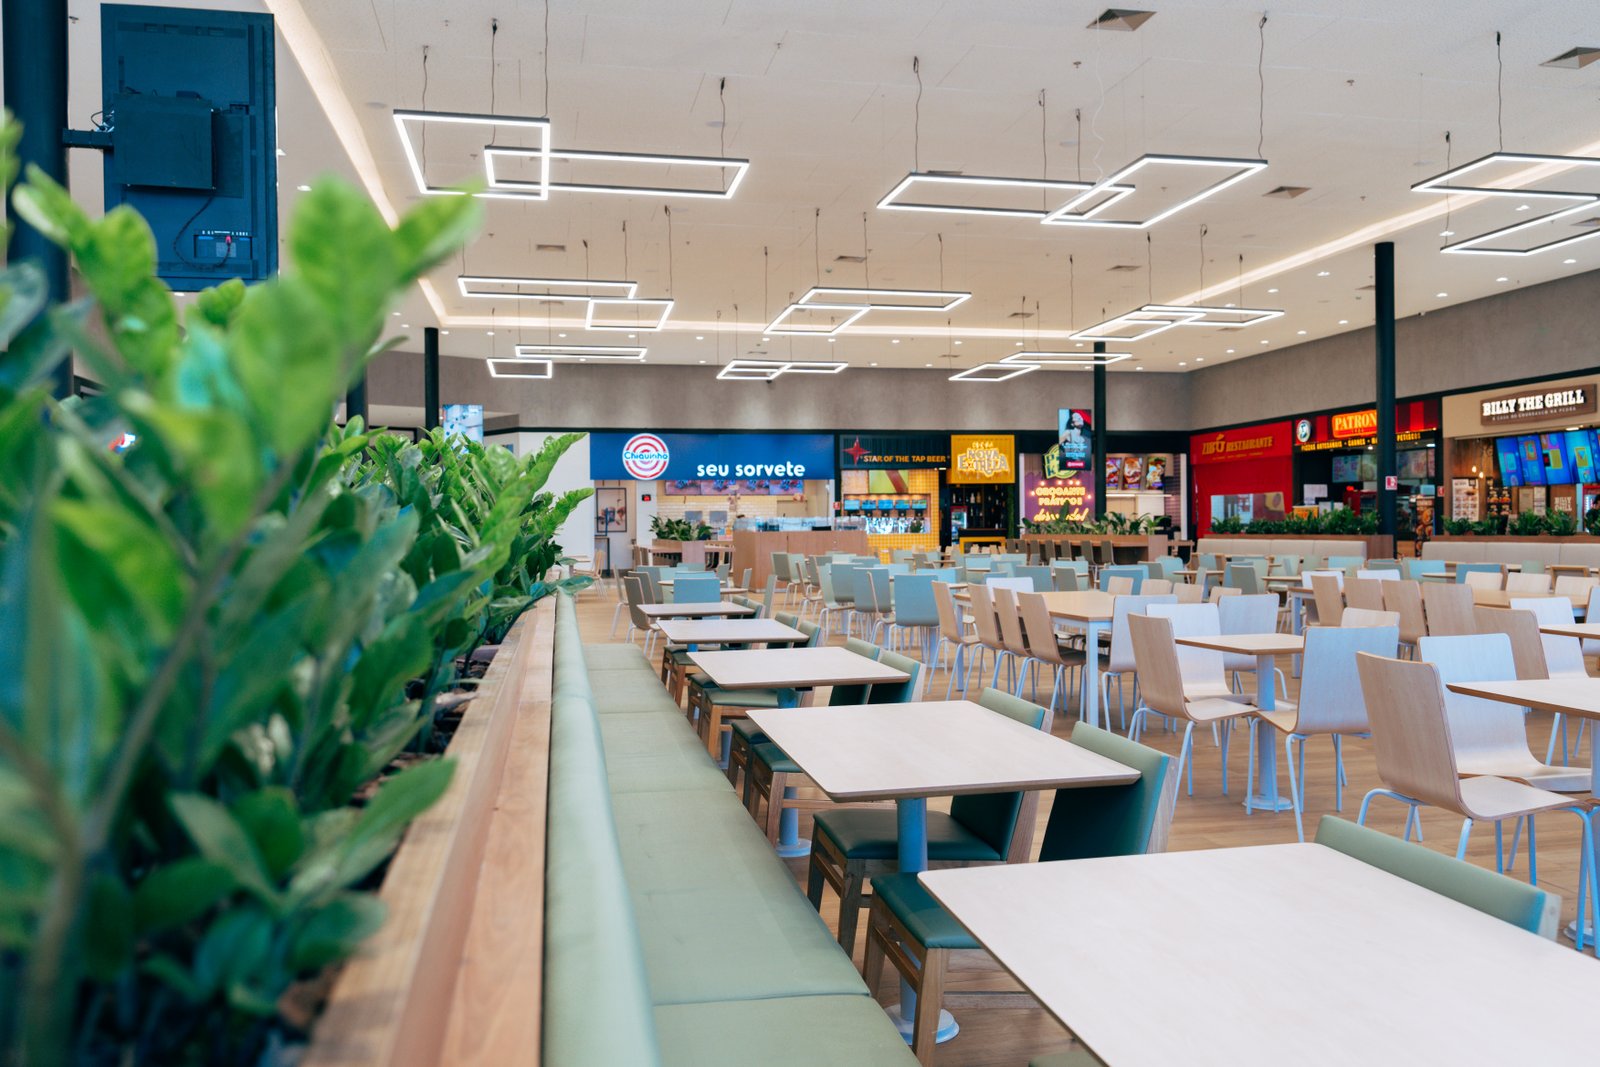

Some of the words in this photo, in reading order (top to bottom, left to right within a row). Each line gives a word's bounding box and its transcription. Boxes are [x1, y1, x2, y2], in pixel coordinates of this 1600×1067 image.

[1482, 398, 1516, 416] BILLY
[1518, 395, 1544, 412] THE
[1544, 389, 1585, 408] GRILL
[883, 455, 893, 463] OF
[895, 455, 909, 463] THE
[911, 455, 925, 463] TAP
[697, 464, 729, 477] seu
[735, 461, 806, 477] sorvete
